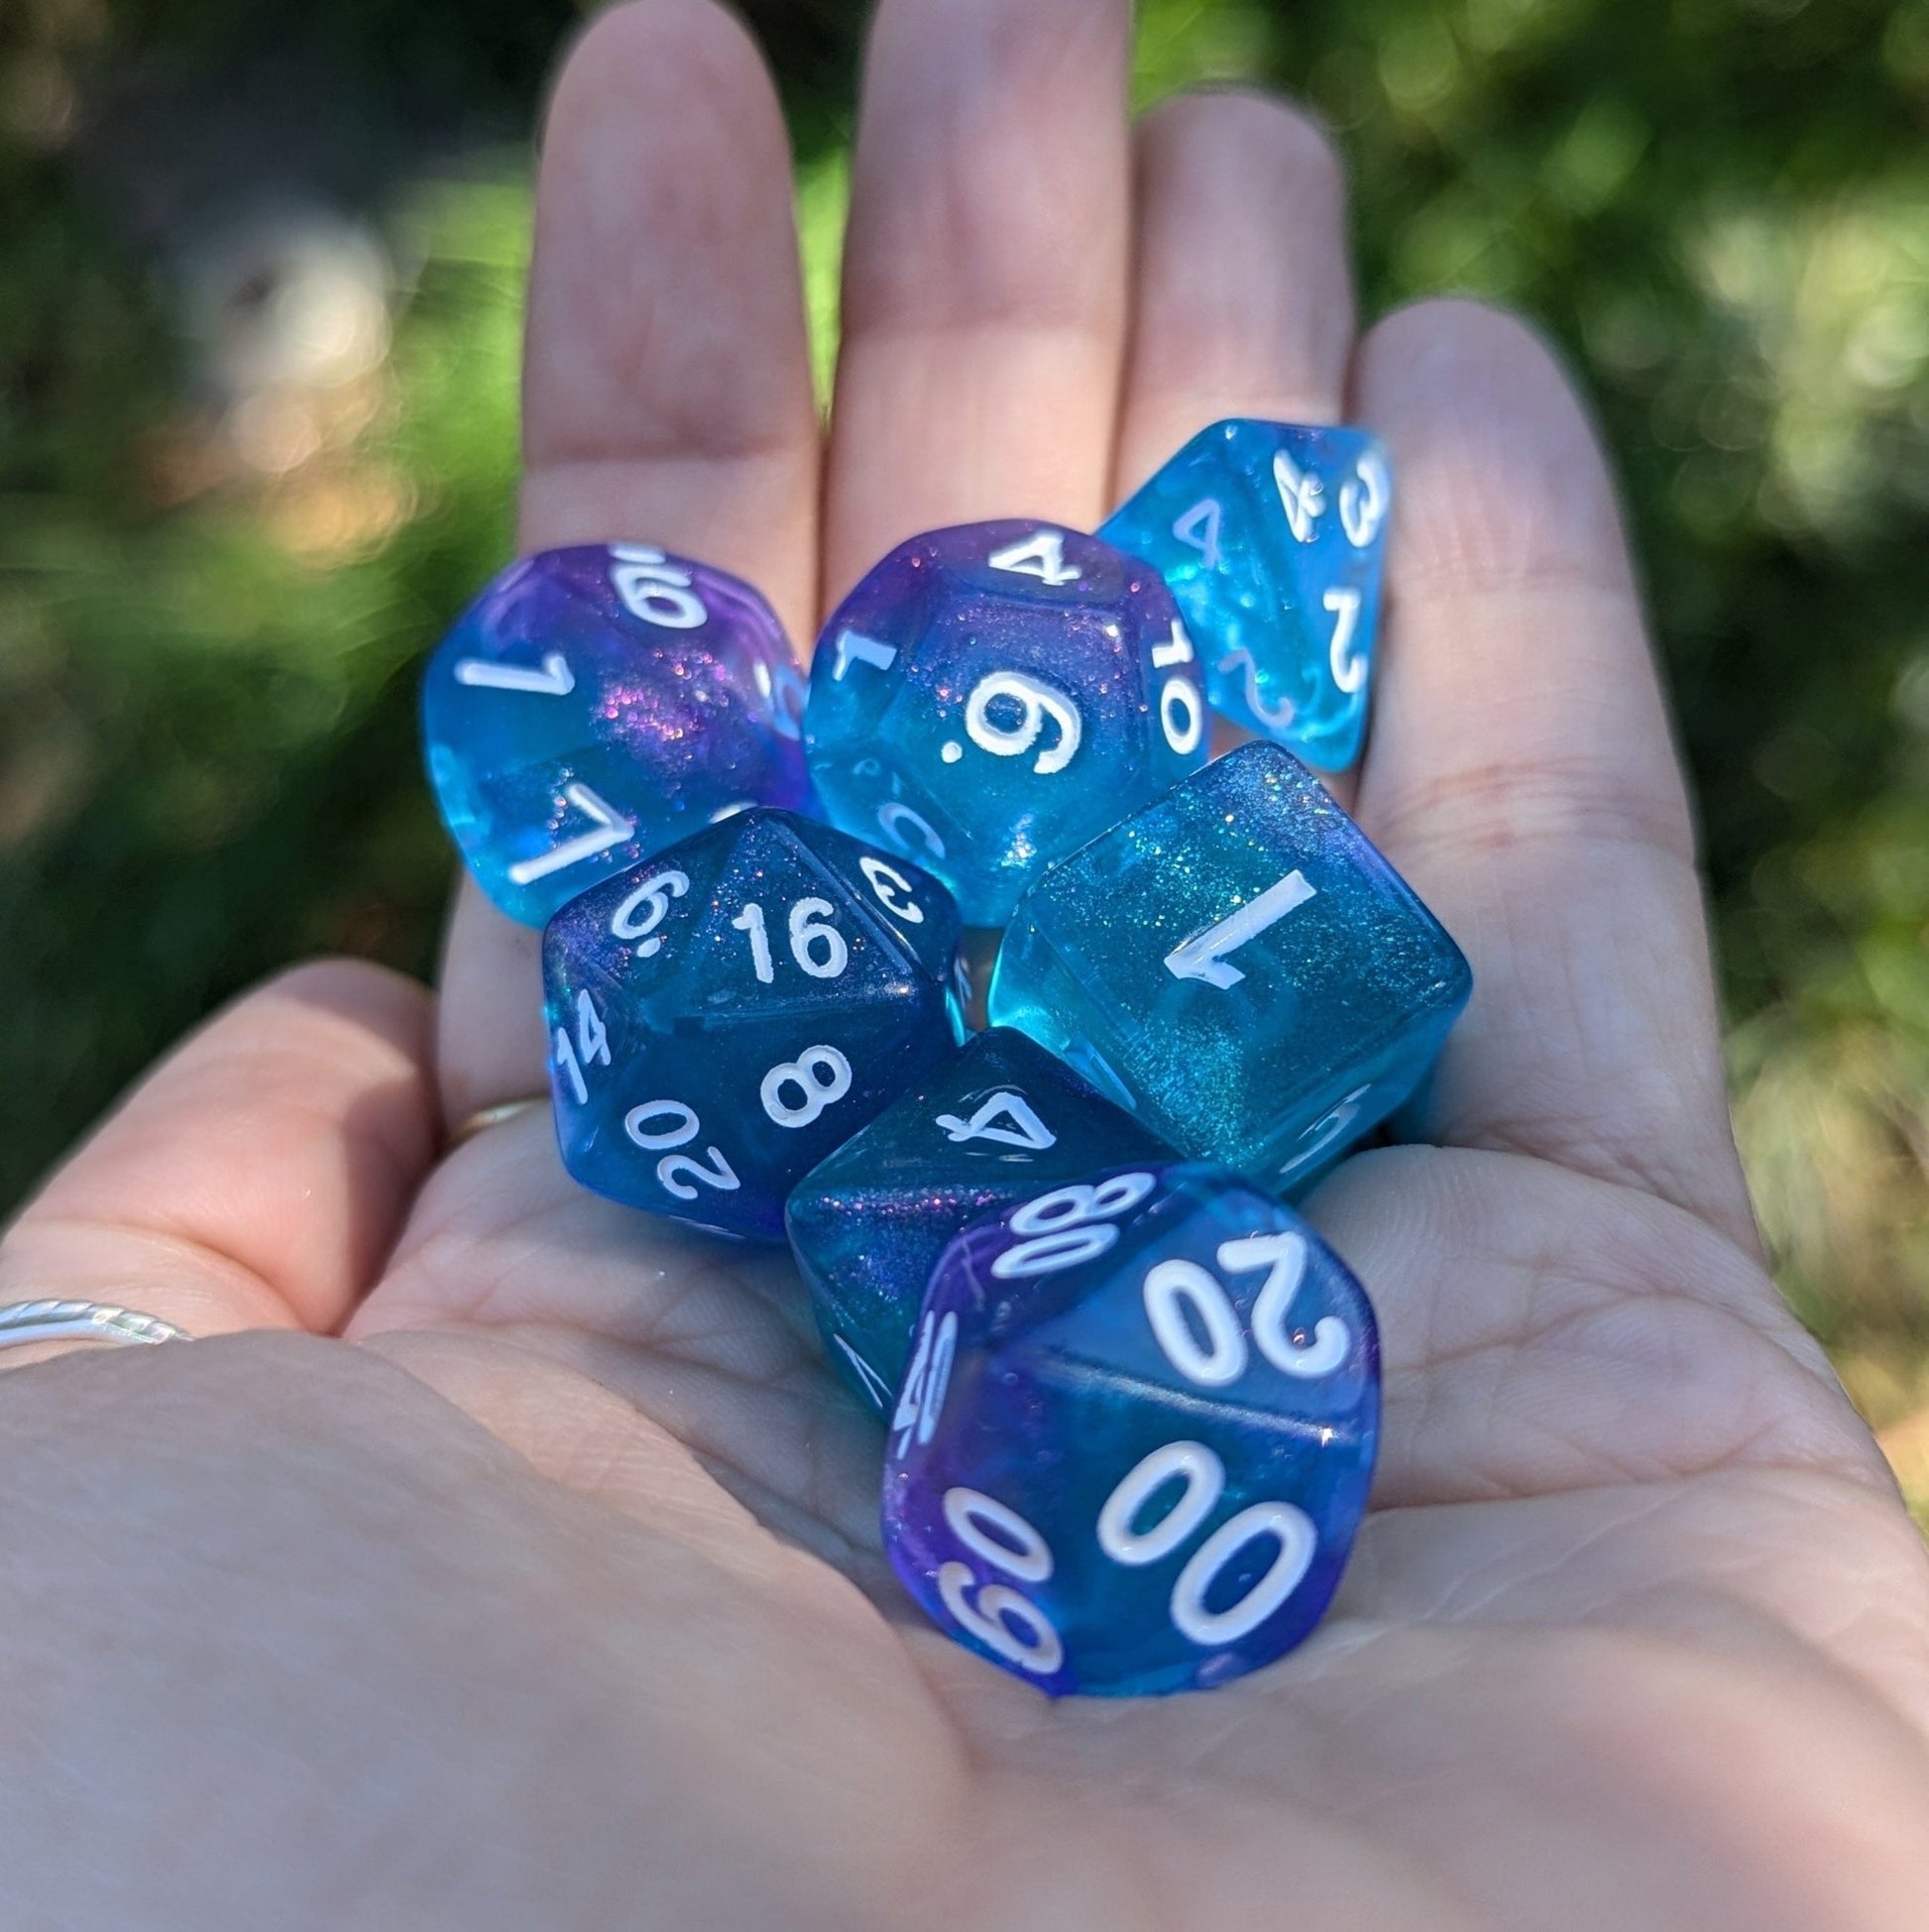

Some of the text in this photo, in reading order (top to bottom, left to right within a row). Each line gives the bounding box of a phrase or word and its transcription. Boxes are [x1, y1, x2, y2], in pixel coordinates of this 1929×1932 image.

[1274, 448, 1326, 543] 4
[1339, 451, 1389, 547] 3
[988, 530, 1082, 586] 4
[1151, 617, 1202, 756] 10
[1323, 588, 1369, 693] 2
[859, 856, 924, 923] 3
[1164, 869, 1317, 989] 1
[732, 897, 849, 983] 16
[556, 989, 612, 1104] 14
[760, 1044, 852, 1128] 8
[624, 1099, 741, 1199] 20
[936, 1091, 1058, 1150] 4
[991, 1173, 1156, 1279] 80
[1143, 1231, 1351, 1387] 20
[1096, 1440, 1318, 1646] 00
